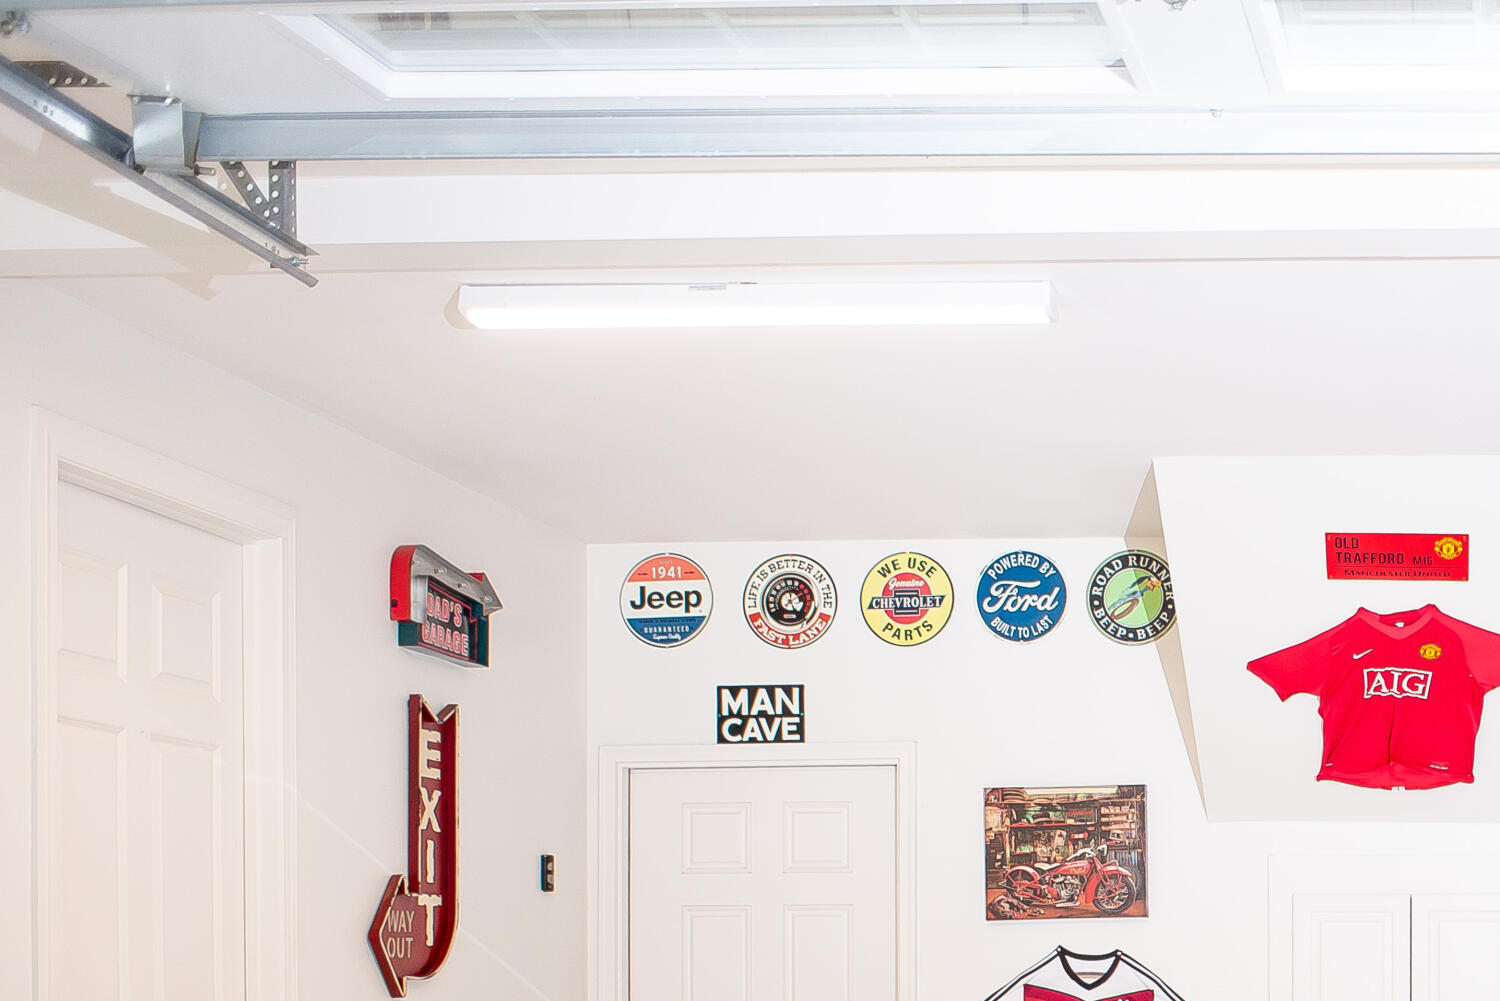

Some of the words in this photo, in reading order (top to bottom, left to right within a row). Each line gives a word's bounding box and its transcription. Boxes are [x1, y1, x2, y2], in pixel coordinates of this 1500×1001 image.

[1334, 536, 1359, 549] OLD
[876, 558, 902, 578] WE
[907, 557, 937, 578] USE
[987, 553, 1040, 580] POWERED
[1039, 561, 1057, 578] BY
[1335, 552, 1405, 564] TRAFFORD
[651, 566, 683, 579] 1941
[747, 581, 761, 609] LIFE
[757, 569, 769, 582] IS
[767, 558, 814, 574] BETTER
[813, 570, 827, 583] IN
[821, 583, 833, 609] THE
[888, 577, 925, 590] Genuine
[1091, 558, 1123, 597] ROAD
[1127, 555, 1174, 601] RUNNER
[629, 585, 702, 613] Jeep
[872, 596, 942, 609] CHEVROLET
[982, 580, 1060, 613] Ford
[427, 592, 462, 627] DAD'S
[643, 625, 690, 633] GUARANTEED
[753, 619, 787, 644] FAST
[788, 619, 827, 645] LANE
[882, 620, 934, 641] PARTS
[990, 616, 1016, 637] BUILT
[1017, 626, 1030, 638] TO
[1030, 615, 1054, 636] LAST
[1093, 608, 1127, 638] BEEP
[1136, 611, 1170, 640] BEEP
[421, 620, 469, 657] GARAGE
[1368, 671, 1425, 694] AIG
[721, 688, 800, 716] MAN
[721, 717, 801, 742] CAVE
[418, 729, 442, 947] EXIT
[388, 911, 415, 933] WAY
[387, 937, 414, 959] OUT
